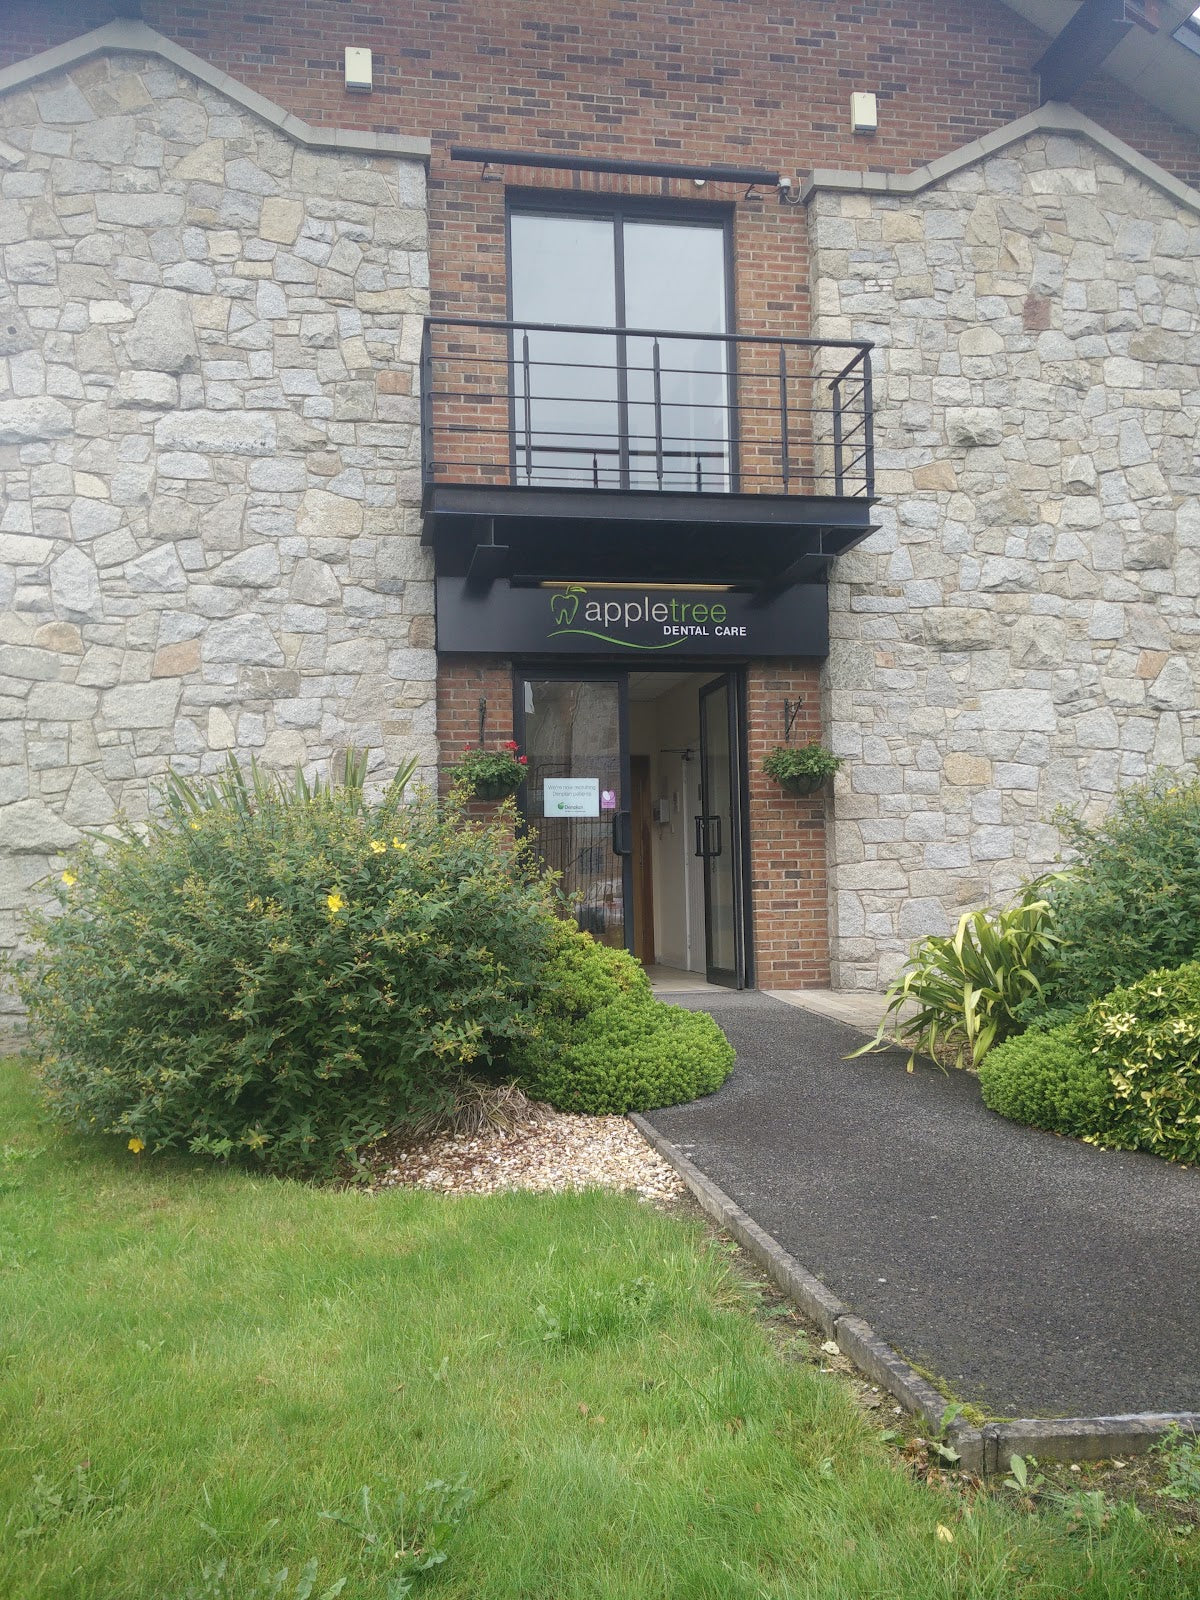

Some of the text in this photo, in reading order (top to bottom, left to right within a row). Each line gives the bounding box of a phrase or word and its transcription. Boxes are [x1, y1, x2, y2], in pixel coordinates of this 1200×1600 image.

[585, 596, 727, 628] appletree
[663, 625, 747, 636] DENTAL CARE
